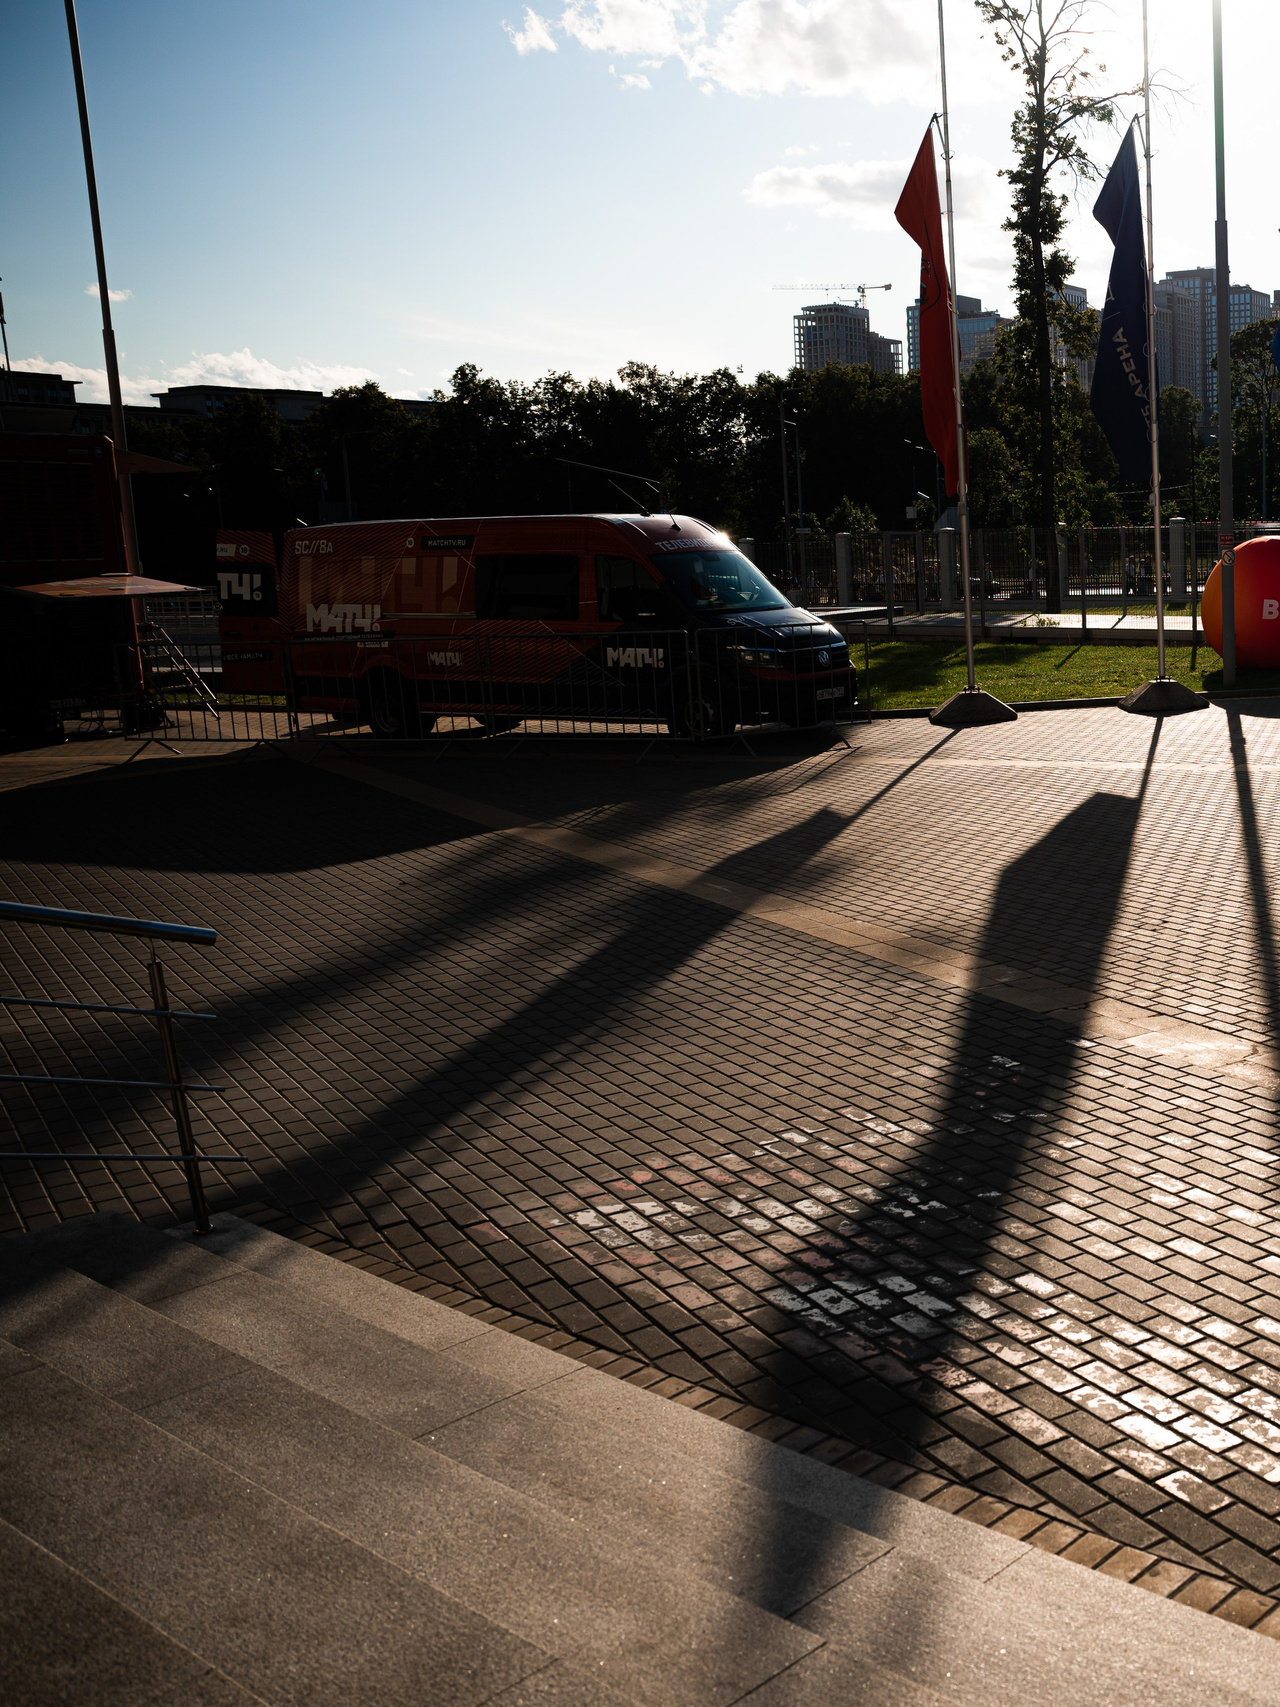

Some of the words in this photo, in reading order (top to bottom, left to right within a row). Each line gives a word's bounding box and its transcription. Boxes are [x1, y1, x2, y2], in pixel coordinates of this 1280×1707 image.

[1111, 326, 1147, 398] АРЕНА
[427, 539, 466, 547] MATCHTV.RU
[306, 603, 381, 633] МАТЧ!
[606, 647, 665, 669] МАТЧ!
